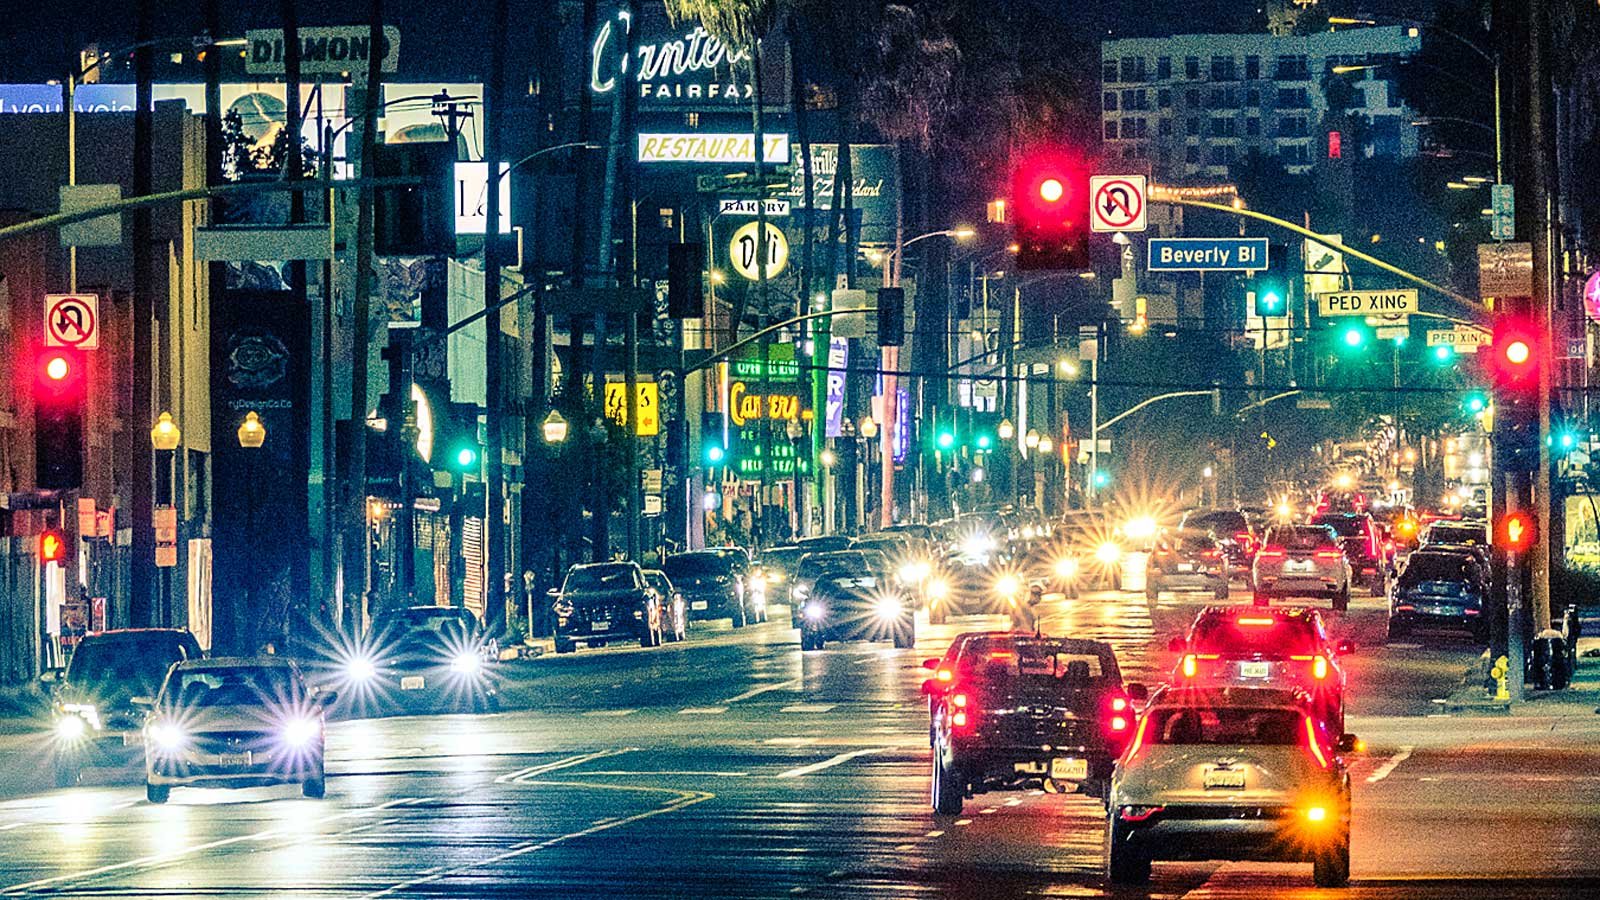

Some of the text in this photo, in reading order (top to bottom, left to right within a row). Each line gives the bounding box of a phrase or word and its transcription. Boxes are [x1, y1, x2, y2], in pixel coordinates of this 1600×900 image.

[253, 37, 391, 63] DIMON
[642, 137, 784, 159] RESTAURAT
[725, 202, 785, 212] BAKRY
[738, 231, 778, 270] Di
[1161, 246, 1256, 267] Beverly Bl
[1329, 295, 1407, 310] PED XING
[1432, 332, 1486, 343] PED XING
